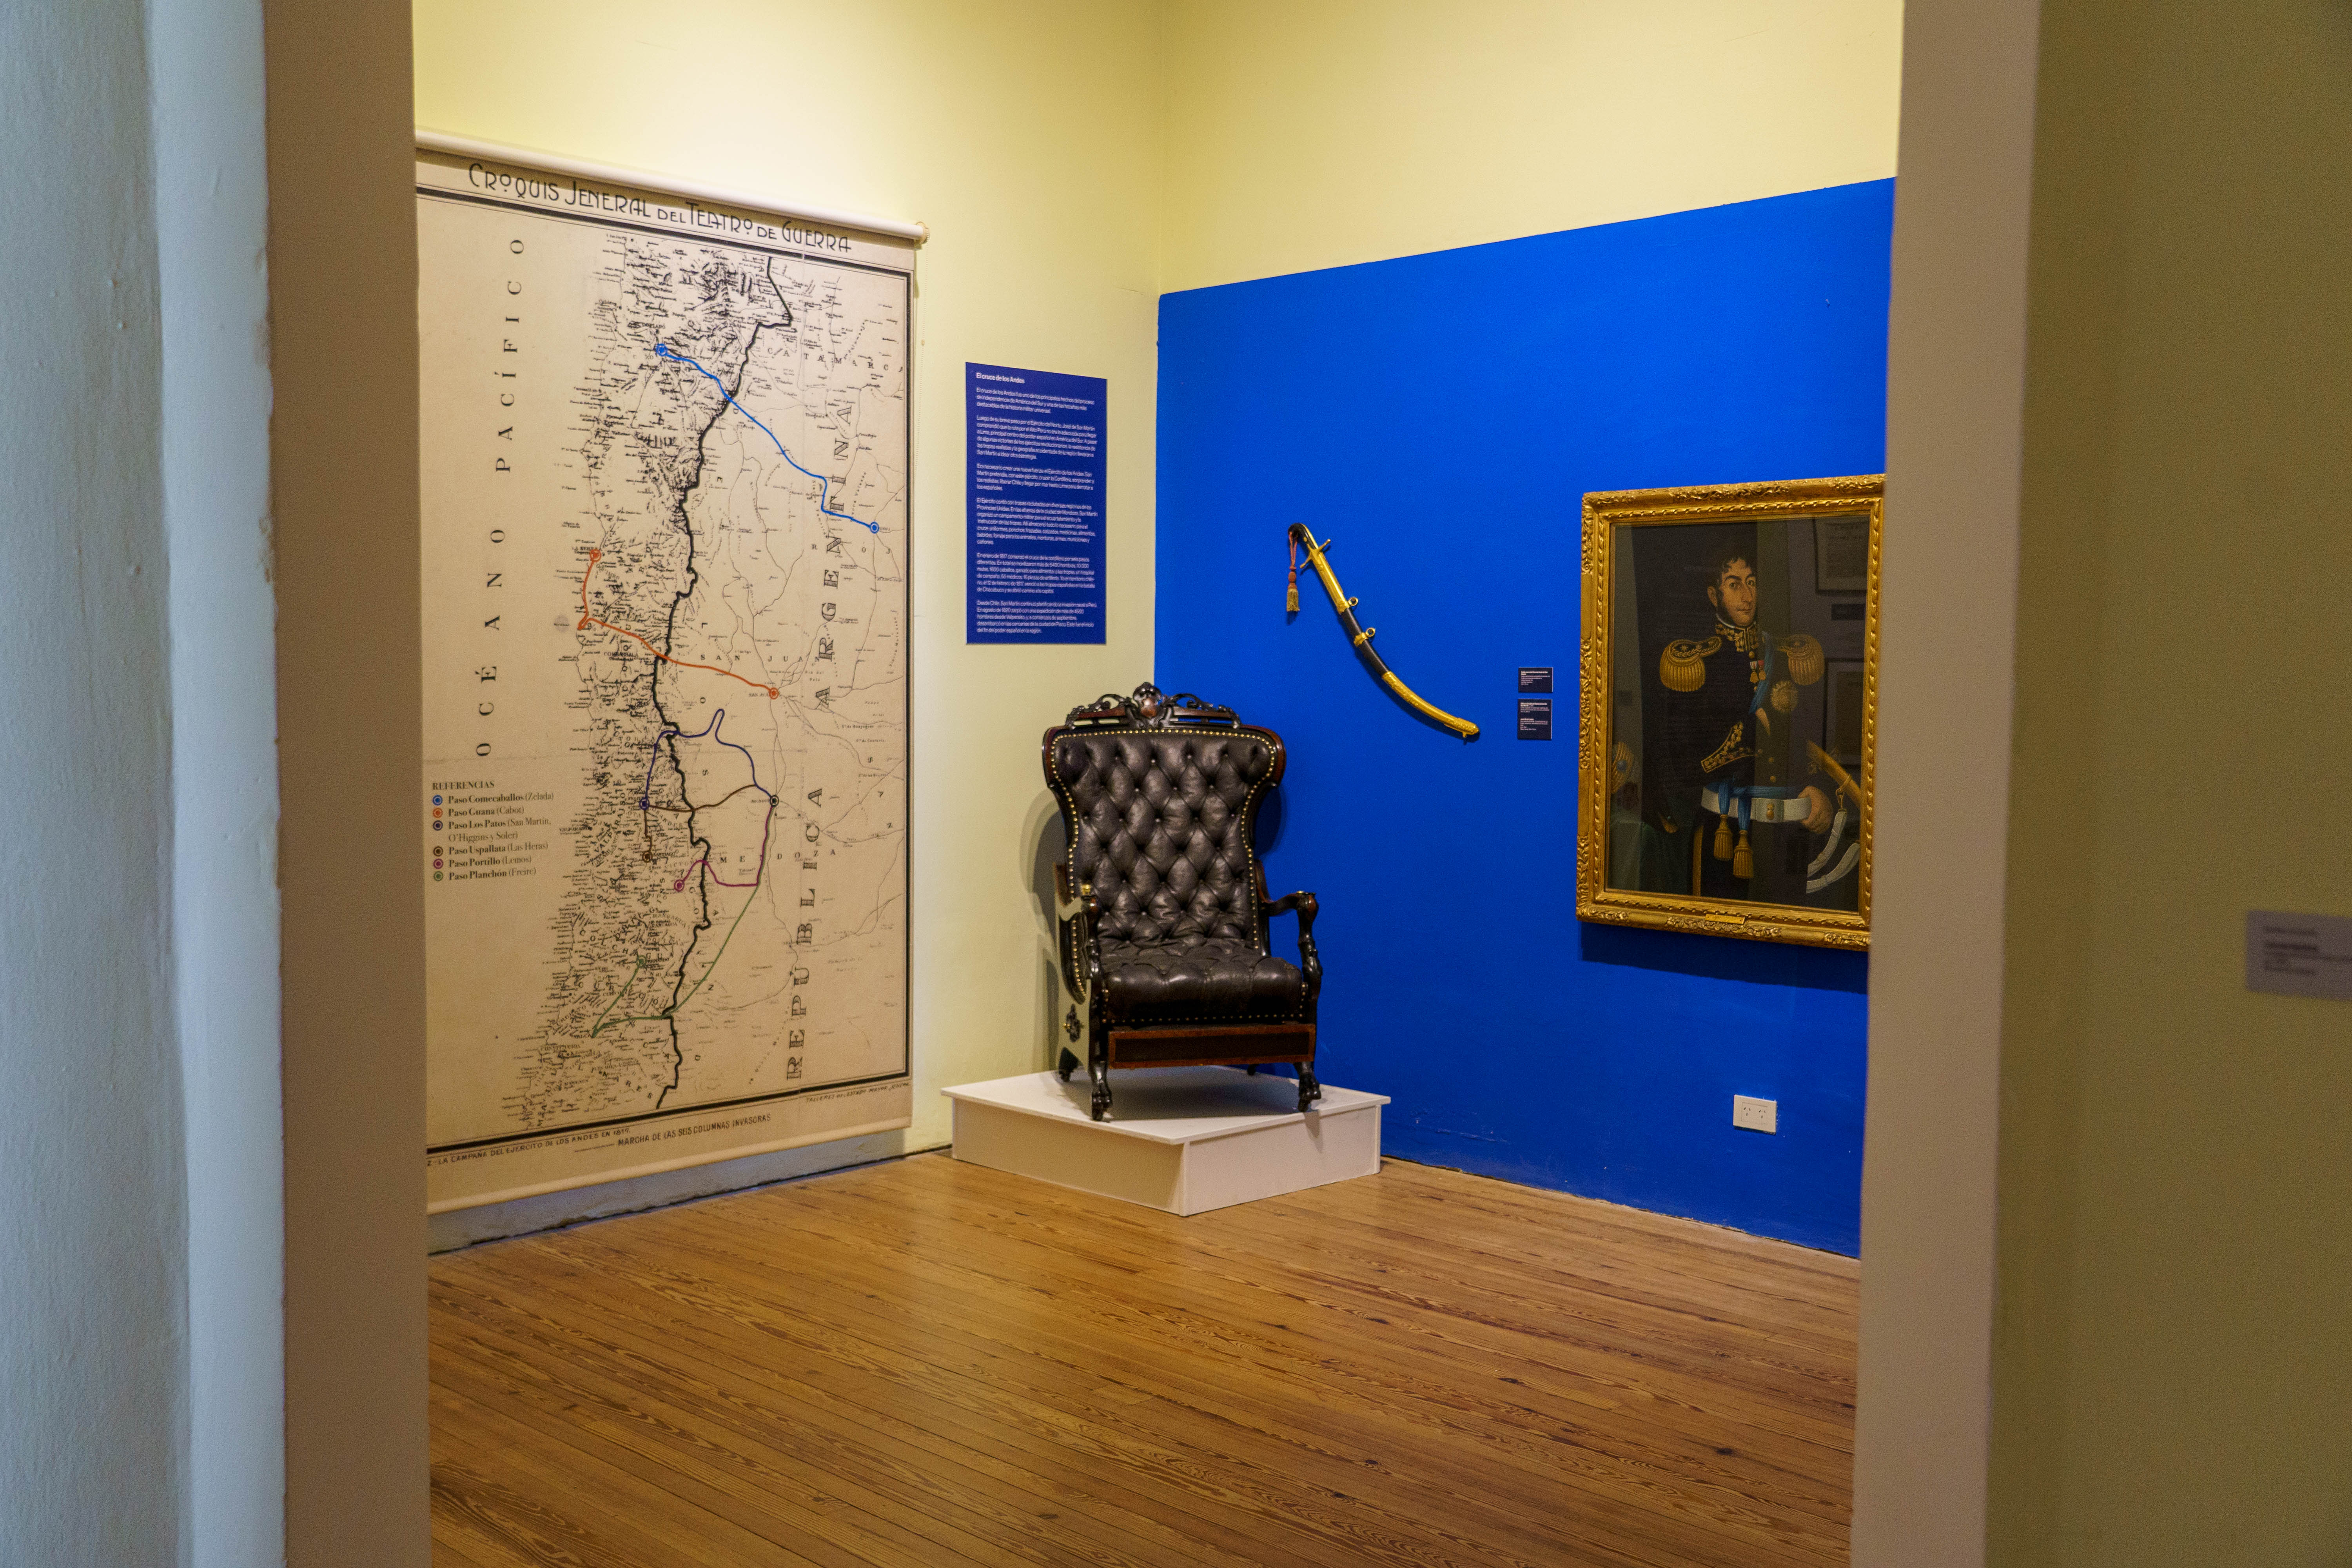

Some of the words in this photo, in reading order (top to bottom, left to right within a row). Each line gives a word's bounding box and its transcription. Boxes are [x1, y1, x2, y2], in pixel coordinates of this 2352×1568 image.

[565, 181, 651, 218] JENERAL
[658, 208, 686, 223] DEL
[757, 226, 777, 240] DE
[782, 220, 851, 253] GUERRA
[815, 404, 854, 708] ARGENTINA
[432, 781, 495, 790] REFERENCIAS
[448, 795, 468, 804] Paso
[468, 793, 524, 803] Comecaballos
[524, 791, 554, 801] (Zelada)
[448, 808, 468, 817] Paso
[497, 806, 524, 815] (Cabot)
[449, 821, 468, 829] Paso
[470, 820, 484, 828] Los
[485, 819, 506, 828] Patos
[508, 818, 524, 827] (San
[495, 831, 518, 840] Soler)
[449, 847, 468, 855] Paso
[470, 845, 506, 856] Uspallata
[507, 843, 523, 852] (Las
[524, 841, 548, 851] Heras)
[449, 859, 468, 867] Paso
[470, 857, 501, 866] Portillo
[502, 856, 532, 865] (Lemos)
[449, 872, 468, 880] Paso
[470, 869, 507, 879] Planchón
[508, 867, 536, 877] (Freire)
[618, 1134, 649, 1147] MARCHA
[664, 1130, 676, 1139] LAS
[693, 1120, 730, 1134] COLUMNAS
[733, 1113, 771, 1127] INVASORAS
[451, 1150, 487, 1163] CAMPAÑA
[491, 1148, 505, 1156] DEL
[506, 1143, 543, 1154] EJERCITO
[556, 1138, 570, 1146] LOS
[571, 1134, 599, 1143] ANDES
